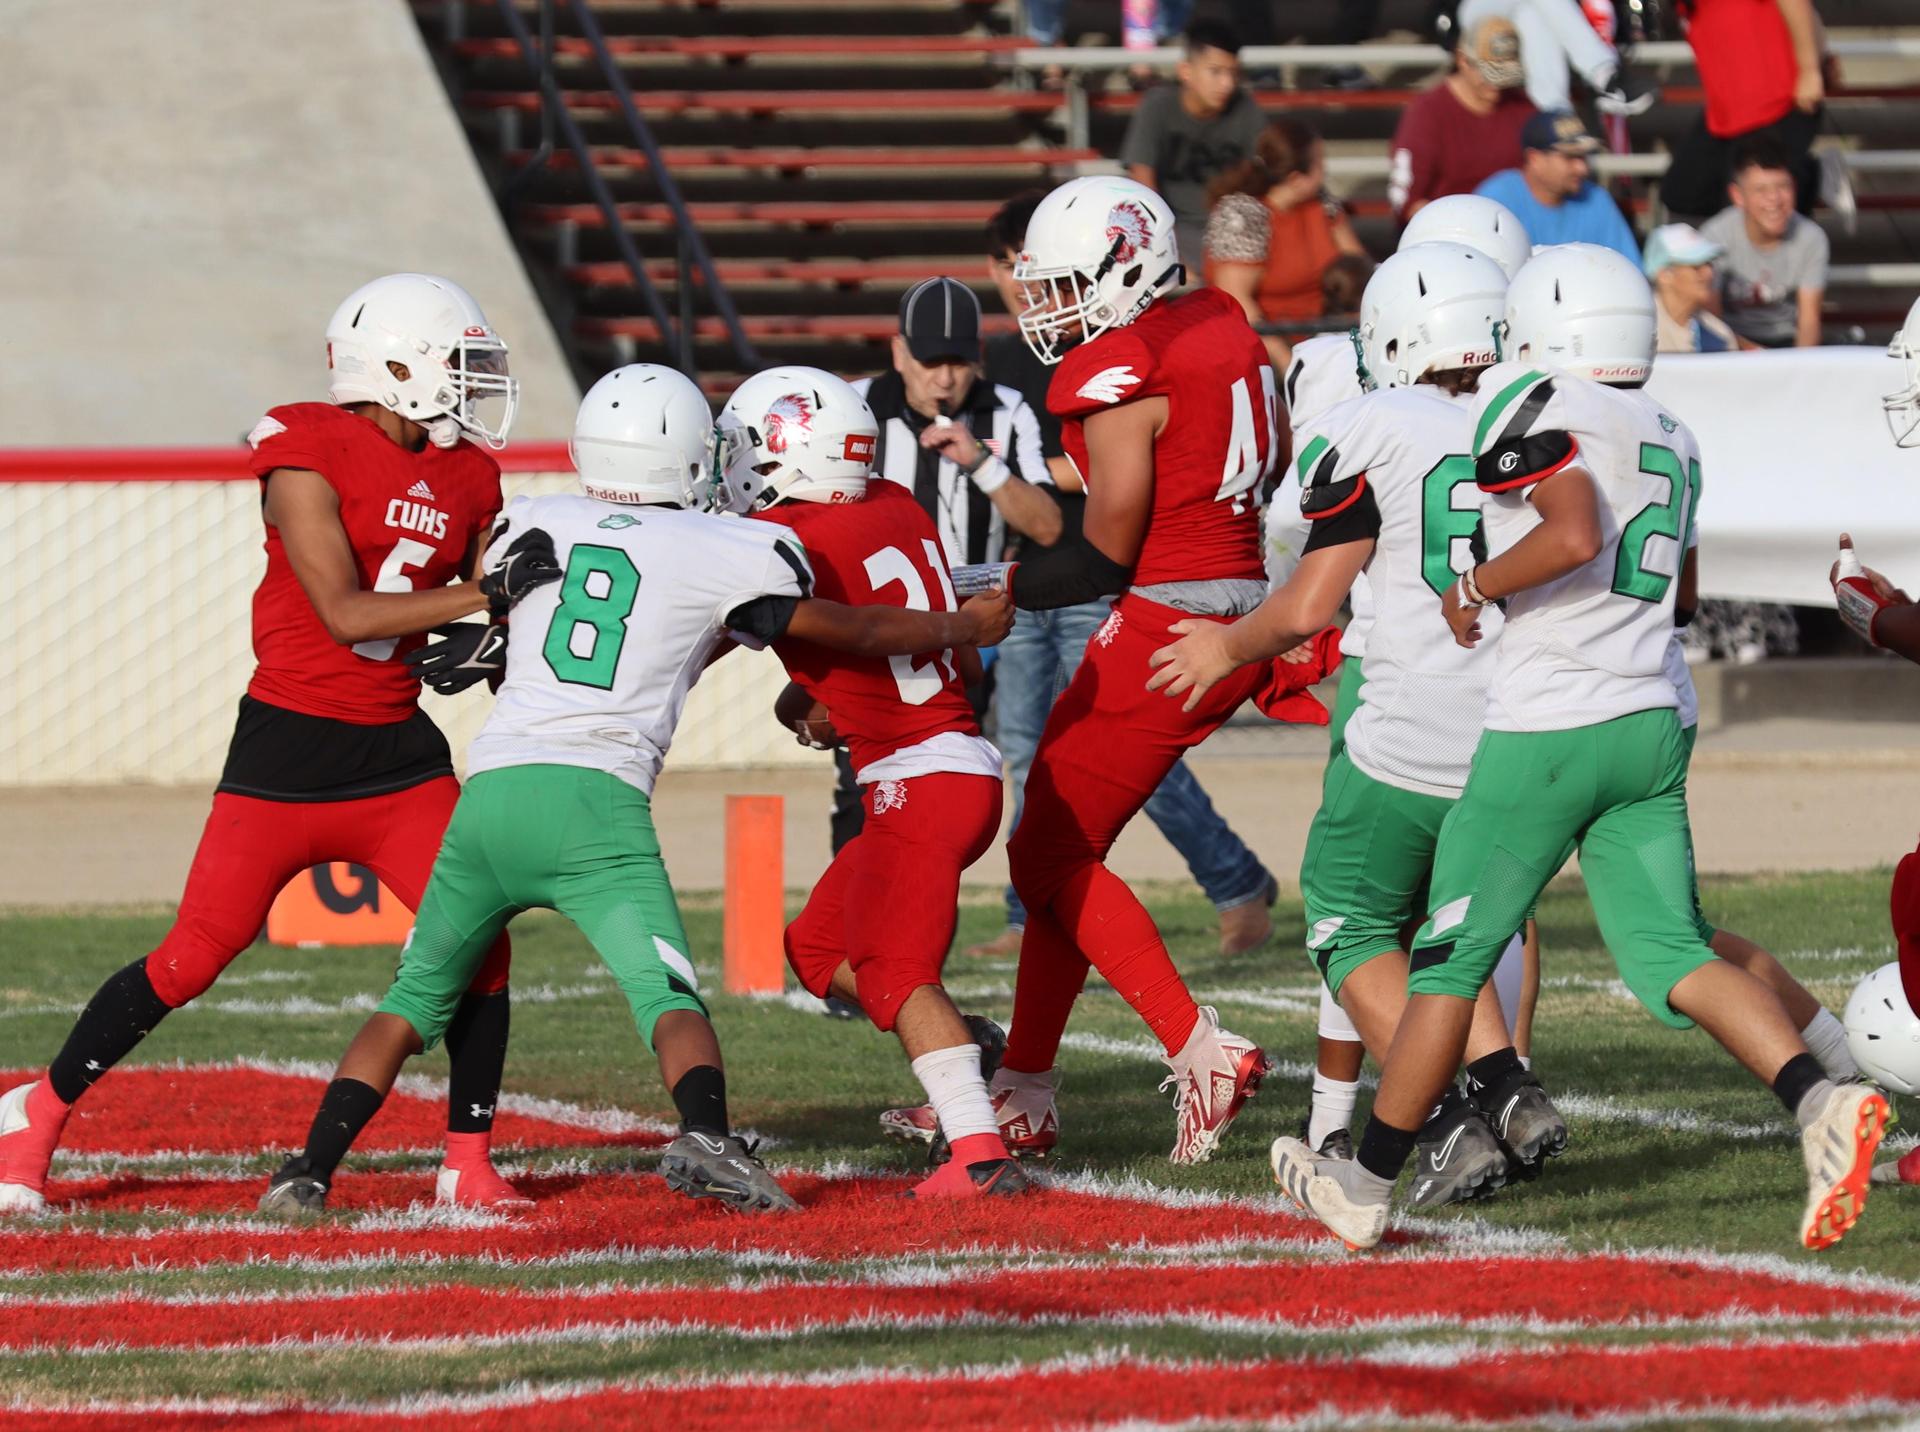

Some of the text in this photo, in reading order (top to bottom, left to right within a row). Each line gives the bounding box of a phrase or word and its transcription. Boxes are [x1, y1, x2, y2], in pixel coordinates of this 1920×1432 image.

[585, 485, 640, 502] Riddell
[385, 498, 450, 540] CUHS
[542, 543, 641, 692] 8
[311, 862, 379, 914] G
